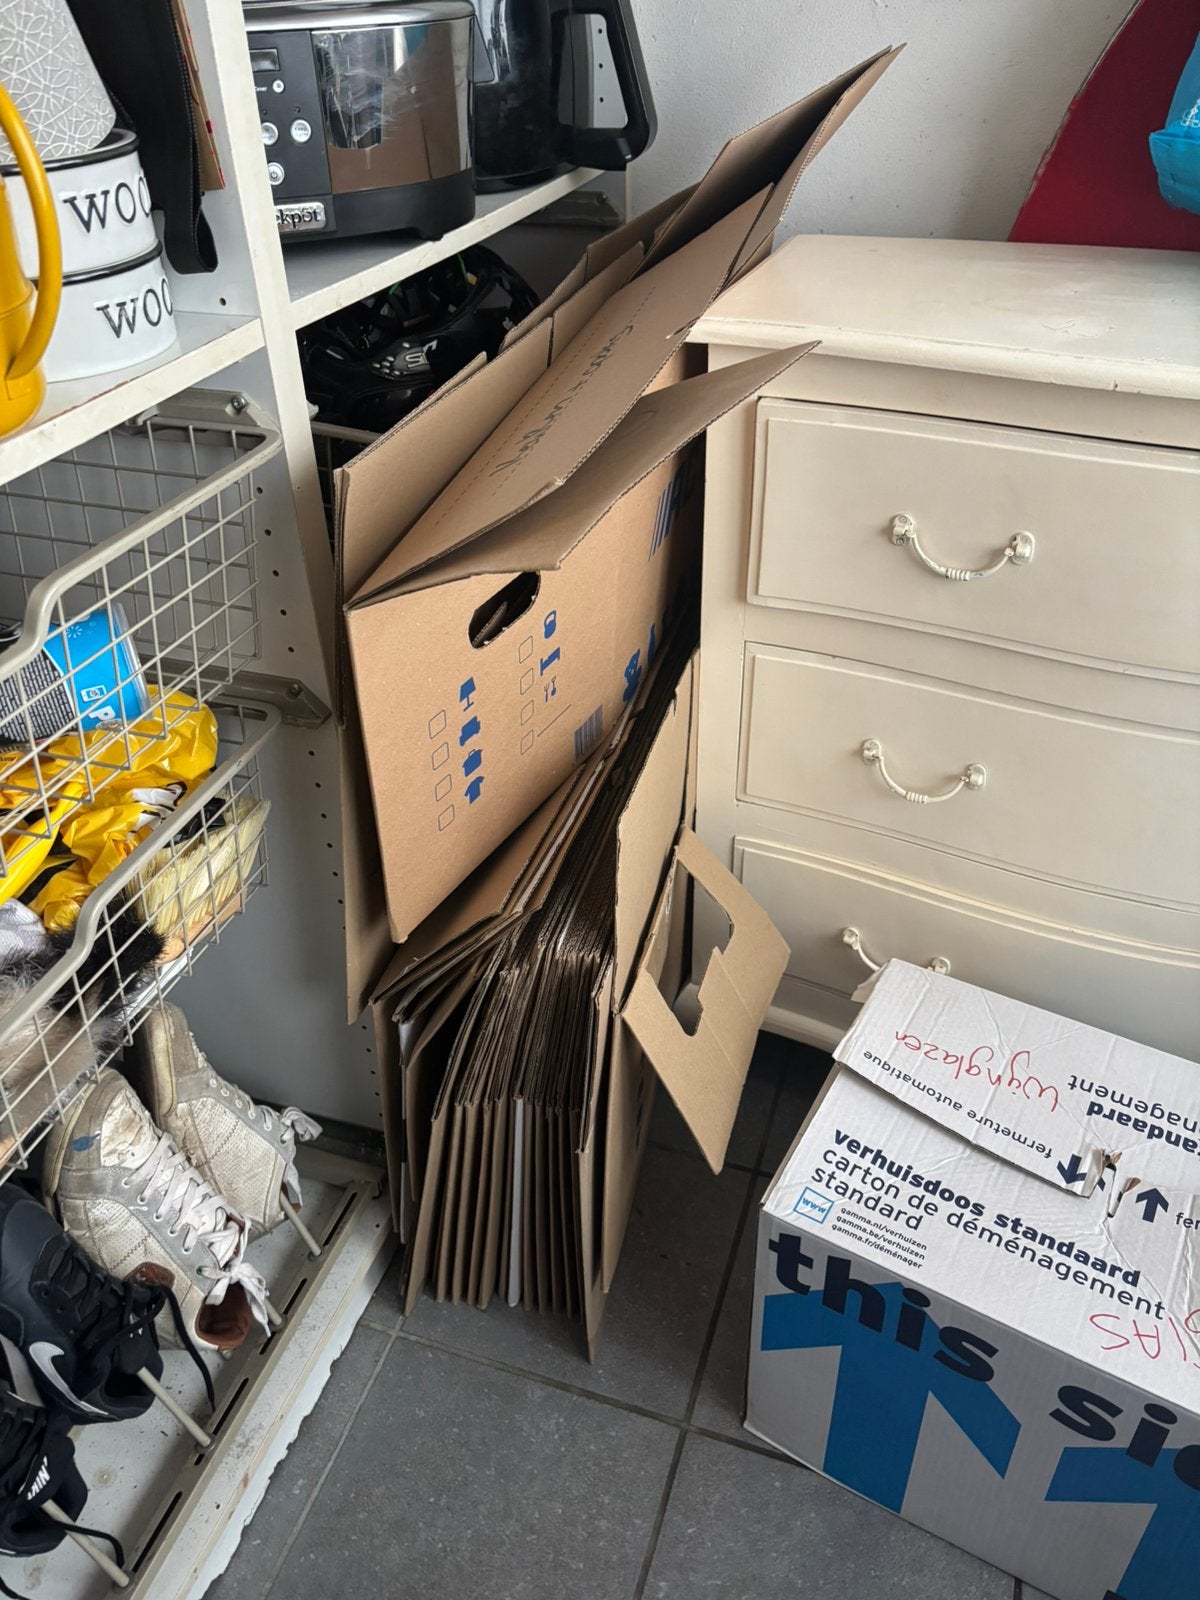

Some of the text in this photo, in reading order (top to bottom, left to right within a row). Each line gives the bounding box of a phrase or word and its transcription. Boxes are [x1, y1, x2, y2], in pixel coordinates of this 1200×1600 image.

[863, 1050, 1053, 1159] fermeture automatique
[1067, 1074, 1200, 1135] nagement
[1086, 1101, 1200, 1155] andaard
[802, 1197, 827, 1214] www
[811, 1167, 924, 1230] standard
[835, 1129, 1141, 1287] verhuisdoos standaard
[840, 1207, 928, 1251] gamma.nl/verhuizen
[822, 1149, 1165, 1320] carton de déménagement
[831, 1223, 924, 1269] gamma.fr/déménager
[835, 1215, 926, 1260] gamma.be/verhuizen
[768, 1233, 999, 1382] this
